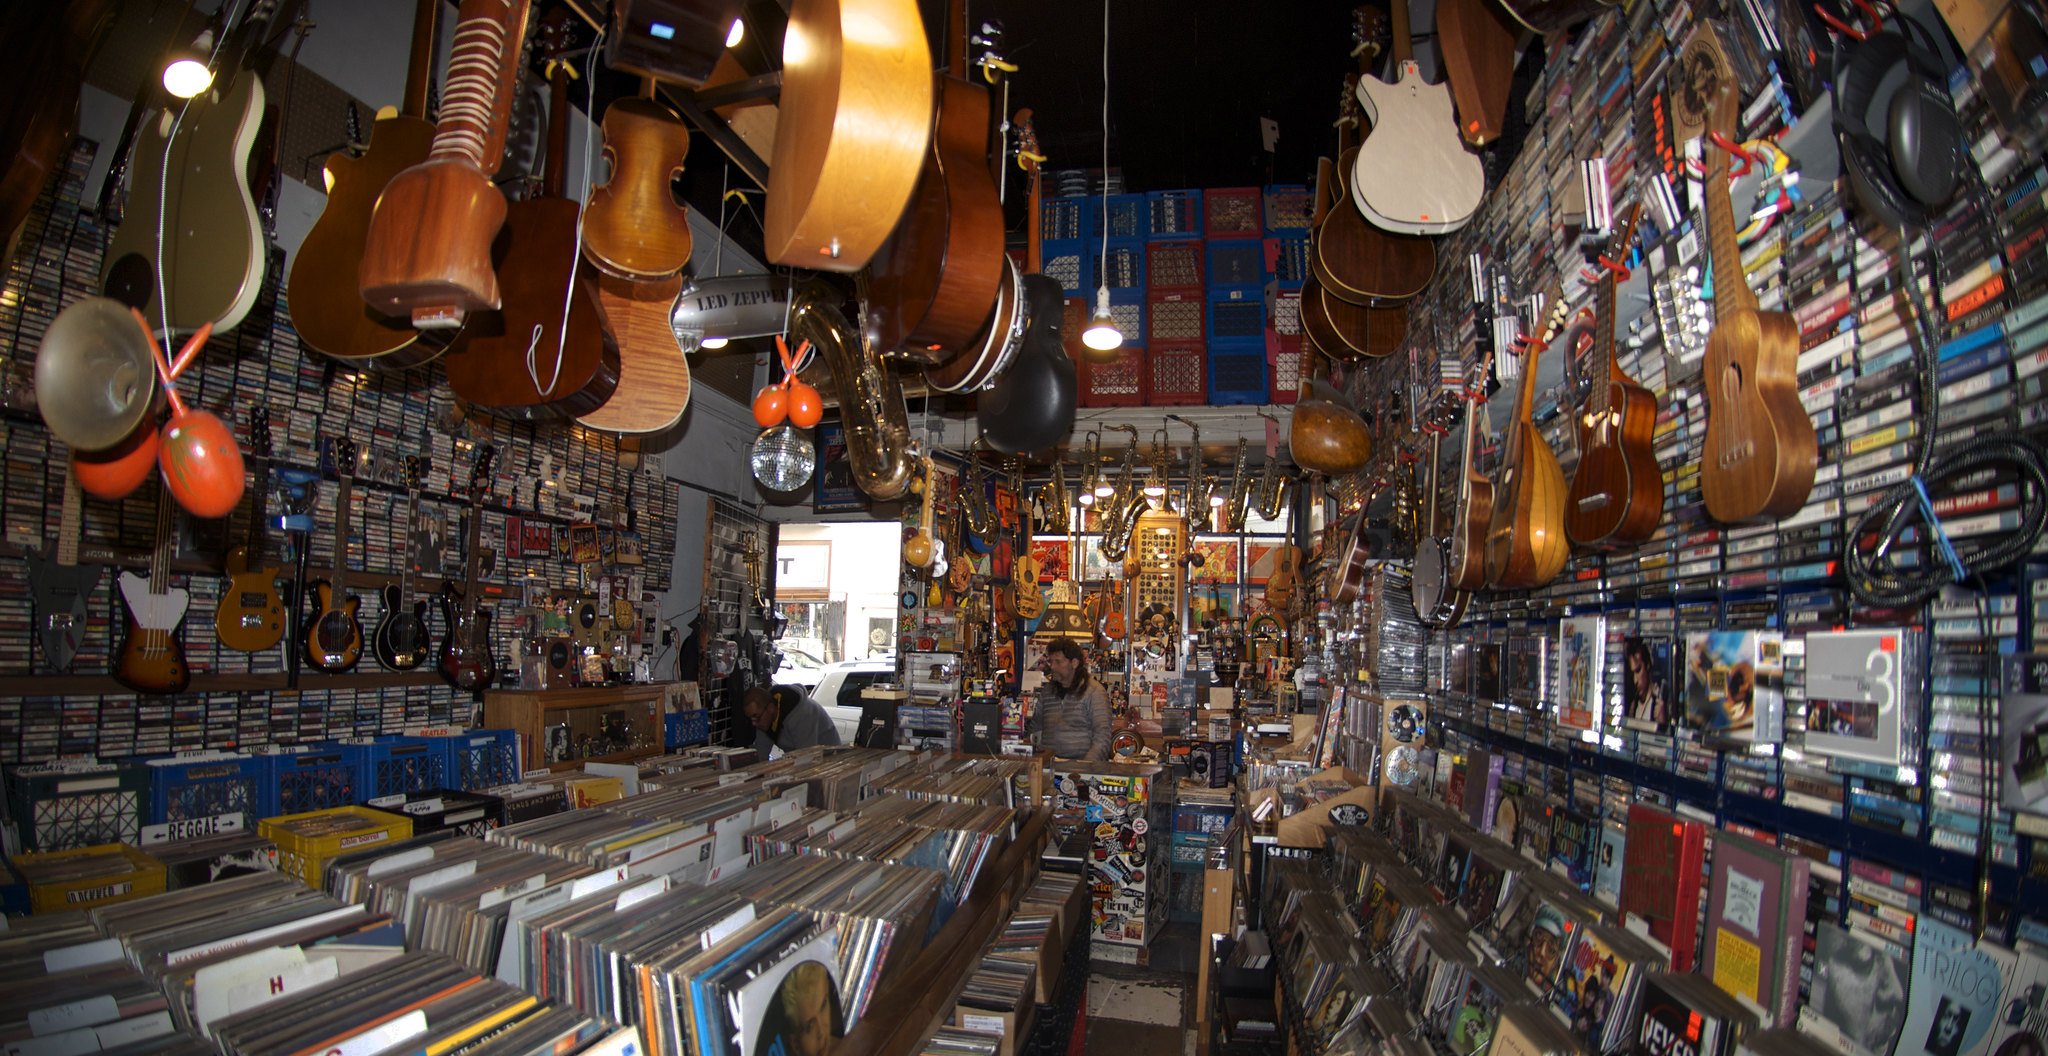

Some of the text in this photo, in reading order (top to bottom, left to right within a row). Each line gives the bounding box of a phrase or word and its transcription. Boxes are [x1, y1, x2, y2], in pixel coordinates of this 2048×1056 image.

[697, 289, 787, 311] LED ZEPPEL
[778, 557, 795, 575] T
[1866, 648, 1895, 716] 3
[420, 729, 448, 737] BEATLES
[247, 746, 271, 755] STONES
[17, 763, 66, 775] HENDRIX
[168, 816, 219, 841] REGGAE
[1553, 812, 1588, 846] planet
[616, 869, 626, 882] K
[1920, 926, 1968, 957] MILES
[1976, 948, 2013, 977] DAVIS
[269, 975, 284, 995] H
[1920, 944, 2007, 1011] TRILOGY
